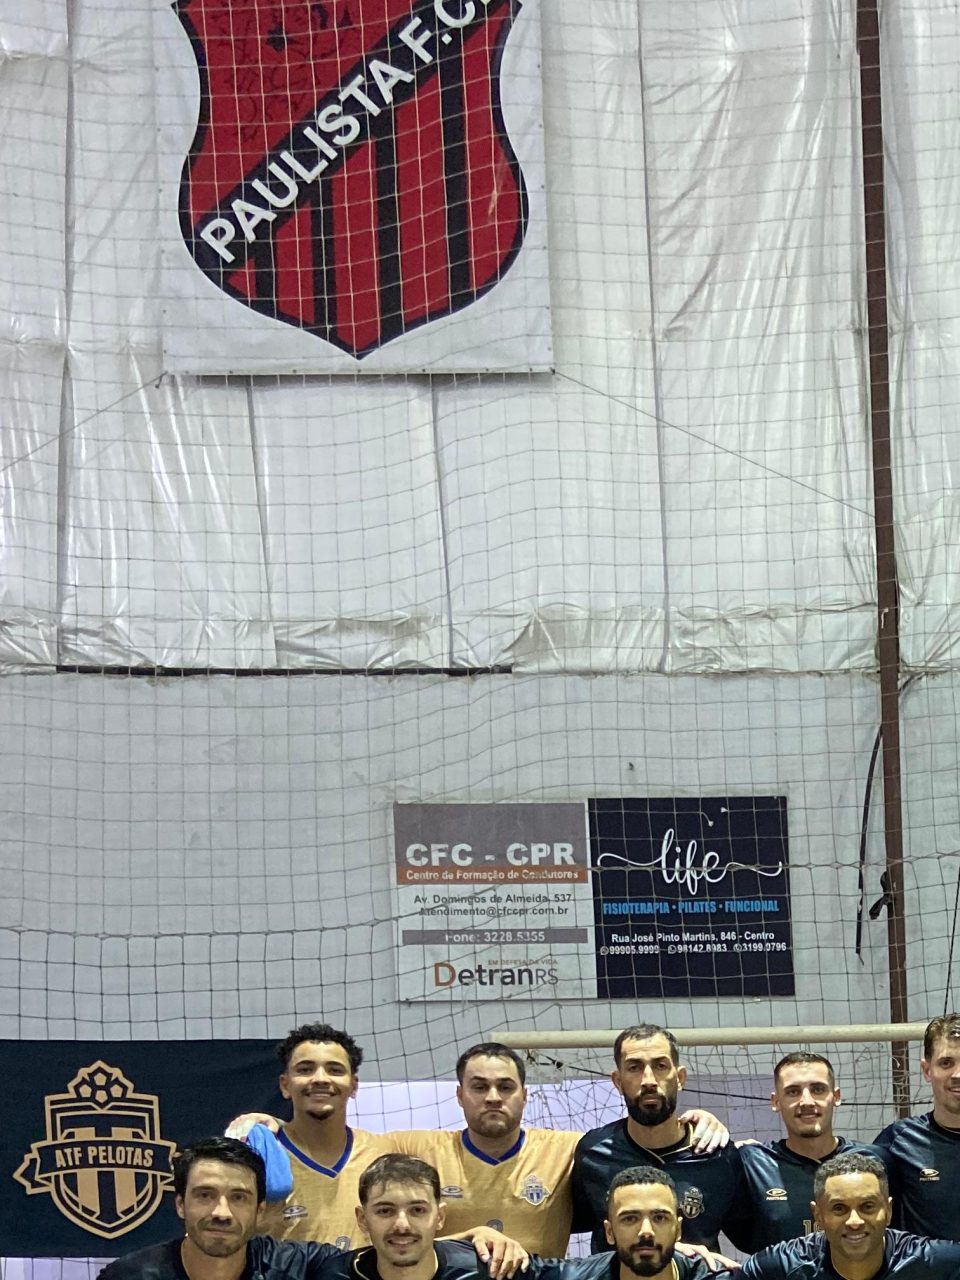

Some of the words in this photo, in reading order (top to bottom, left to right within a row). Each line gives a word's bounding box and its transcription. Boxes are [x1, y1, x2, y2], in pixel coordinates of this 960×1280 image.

[200, 58, 415, 263] PAULISTA
[406, 843, 473, 867] CFC
[506, 842, 577, 866] CPR
[406, 870, 439, 880] Centro
[441, 870, 454, 880] de
[456, 869, 505, 882] Formação
[507, 870, 519, 880] de
[522, 869, 578, 880] Condutores
[414, 895, 430, 904] Av.
[433, 894, 486, 906] Domingos
[490, 894, 502, 903] de
[554, 894, 572, 903] 537
[603, 902, 670, 915] FISIOTERAPIA
[678, 901, 717, 914] PILATES
[725, 900, 780, 913] FUNCIONAL
[612, 934, 630, 943] Rua
[632, 932, 654, 943] José
[656, 932, 680, 942] Pinto
[682, 932, 718, 943] Martins,
[720, 931, 737, 941] 846
[744, 930, 775, 941] Centro
[55, 1147, 82, 1168] ATF
[88, 1145, 154, 1168] PELOTAS
